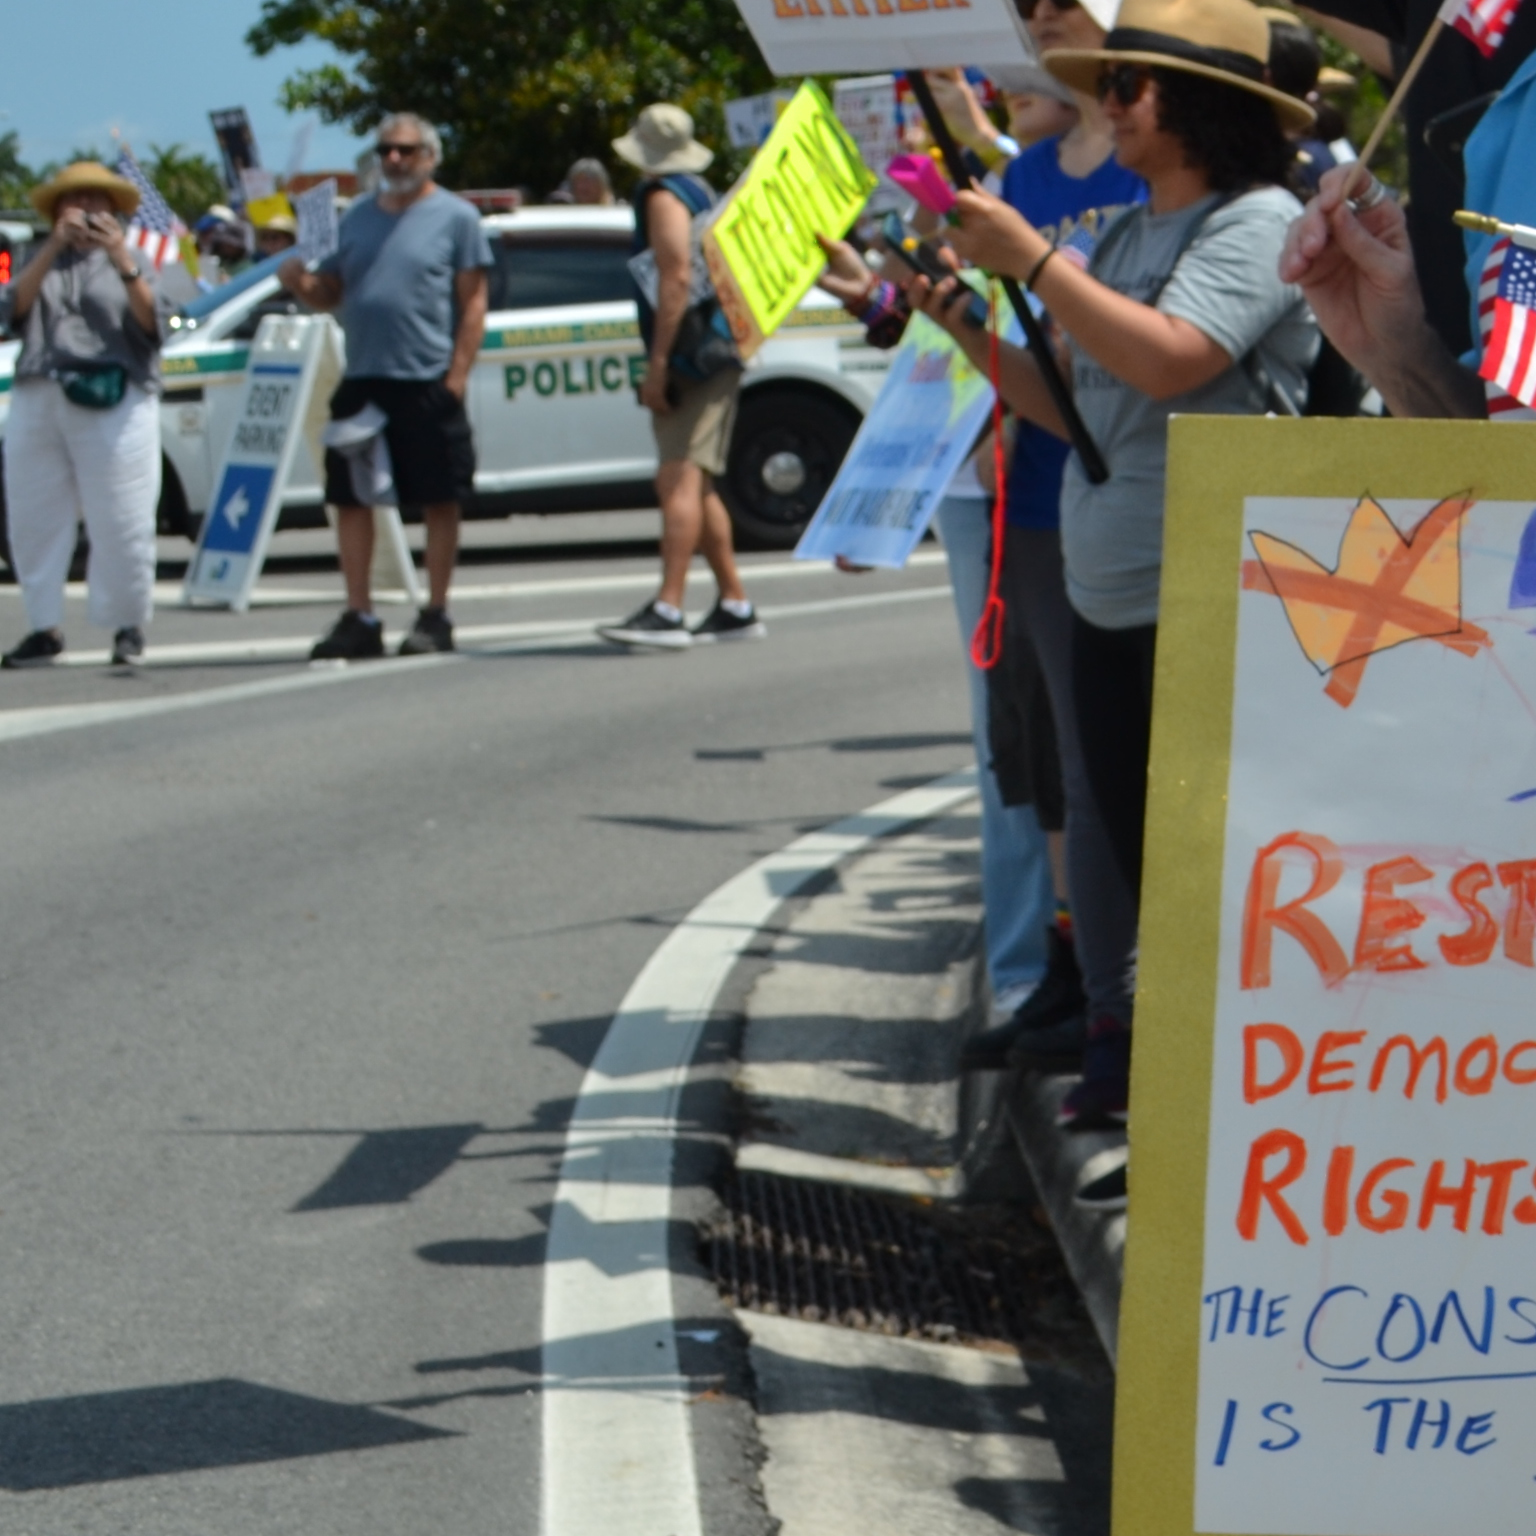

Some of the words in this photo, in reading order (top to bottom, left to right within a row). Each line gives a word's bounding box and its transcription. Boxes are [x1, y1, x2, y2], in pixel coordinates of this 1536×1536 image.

[503, 353, 648, 400] POLICE
[1203, 1285, 1291, 1344] THE
[1213, 1397, 1302, 1466] IS
[1363, 1396, 1498, 1458] THE
